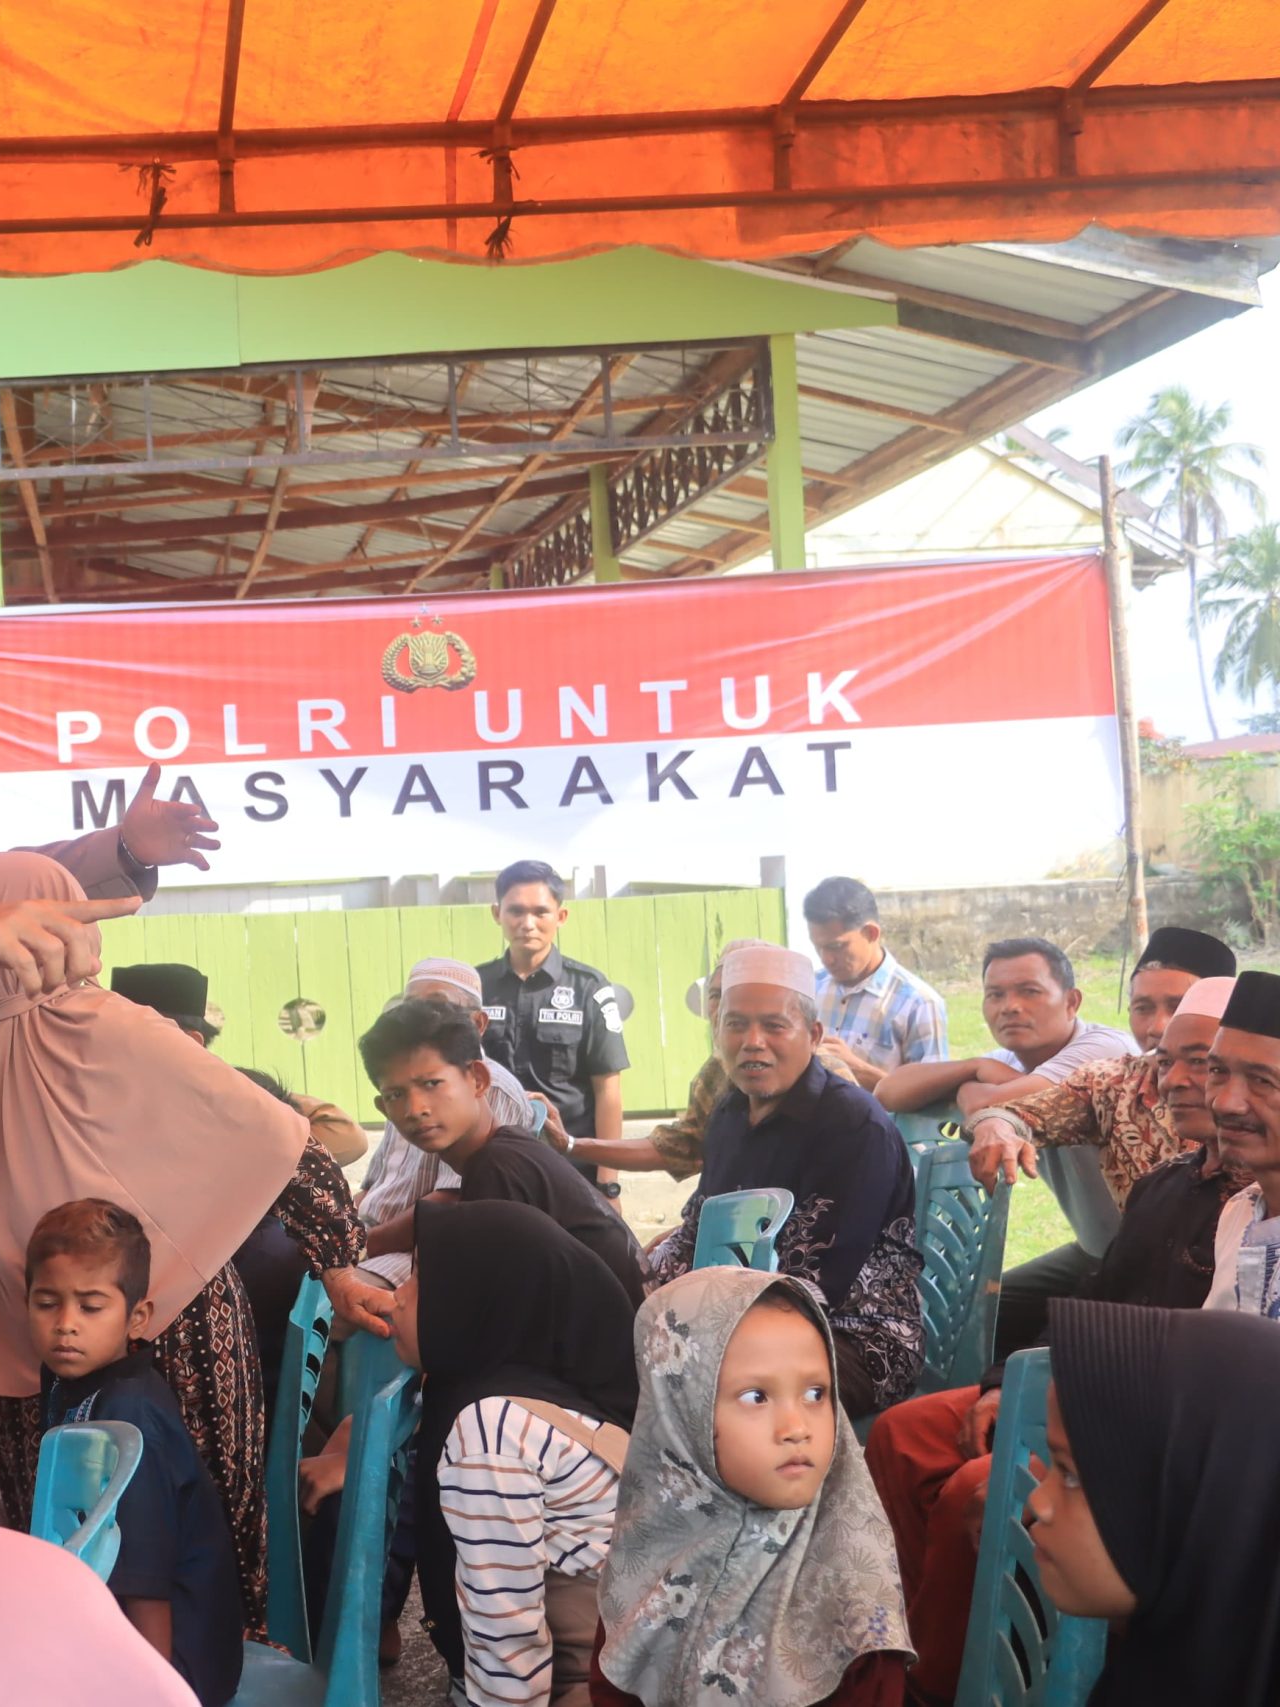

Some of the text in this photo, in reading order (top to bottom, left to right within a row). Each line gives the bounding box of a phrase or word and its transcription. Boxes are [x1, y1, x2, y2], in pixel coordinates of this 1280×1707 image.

[56, 669, 862, 764] POLRI UNTUK
[71, 740, 852, 830] MASYARAKAT
